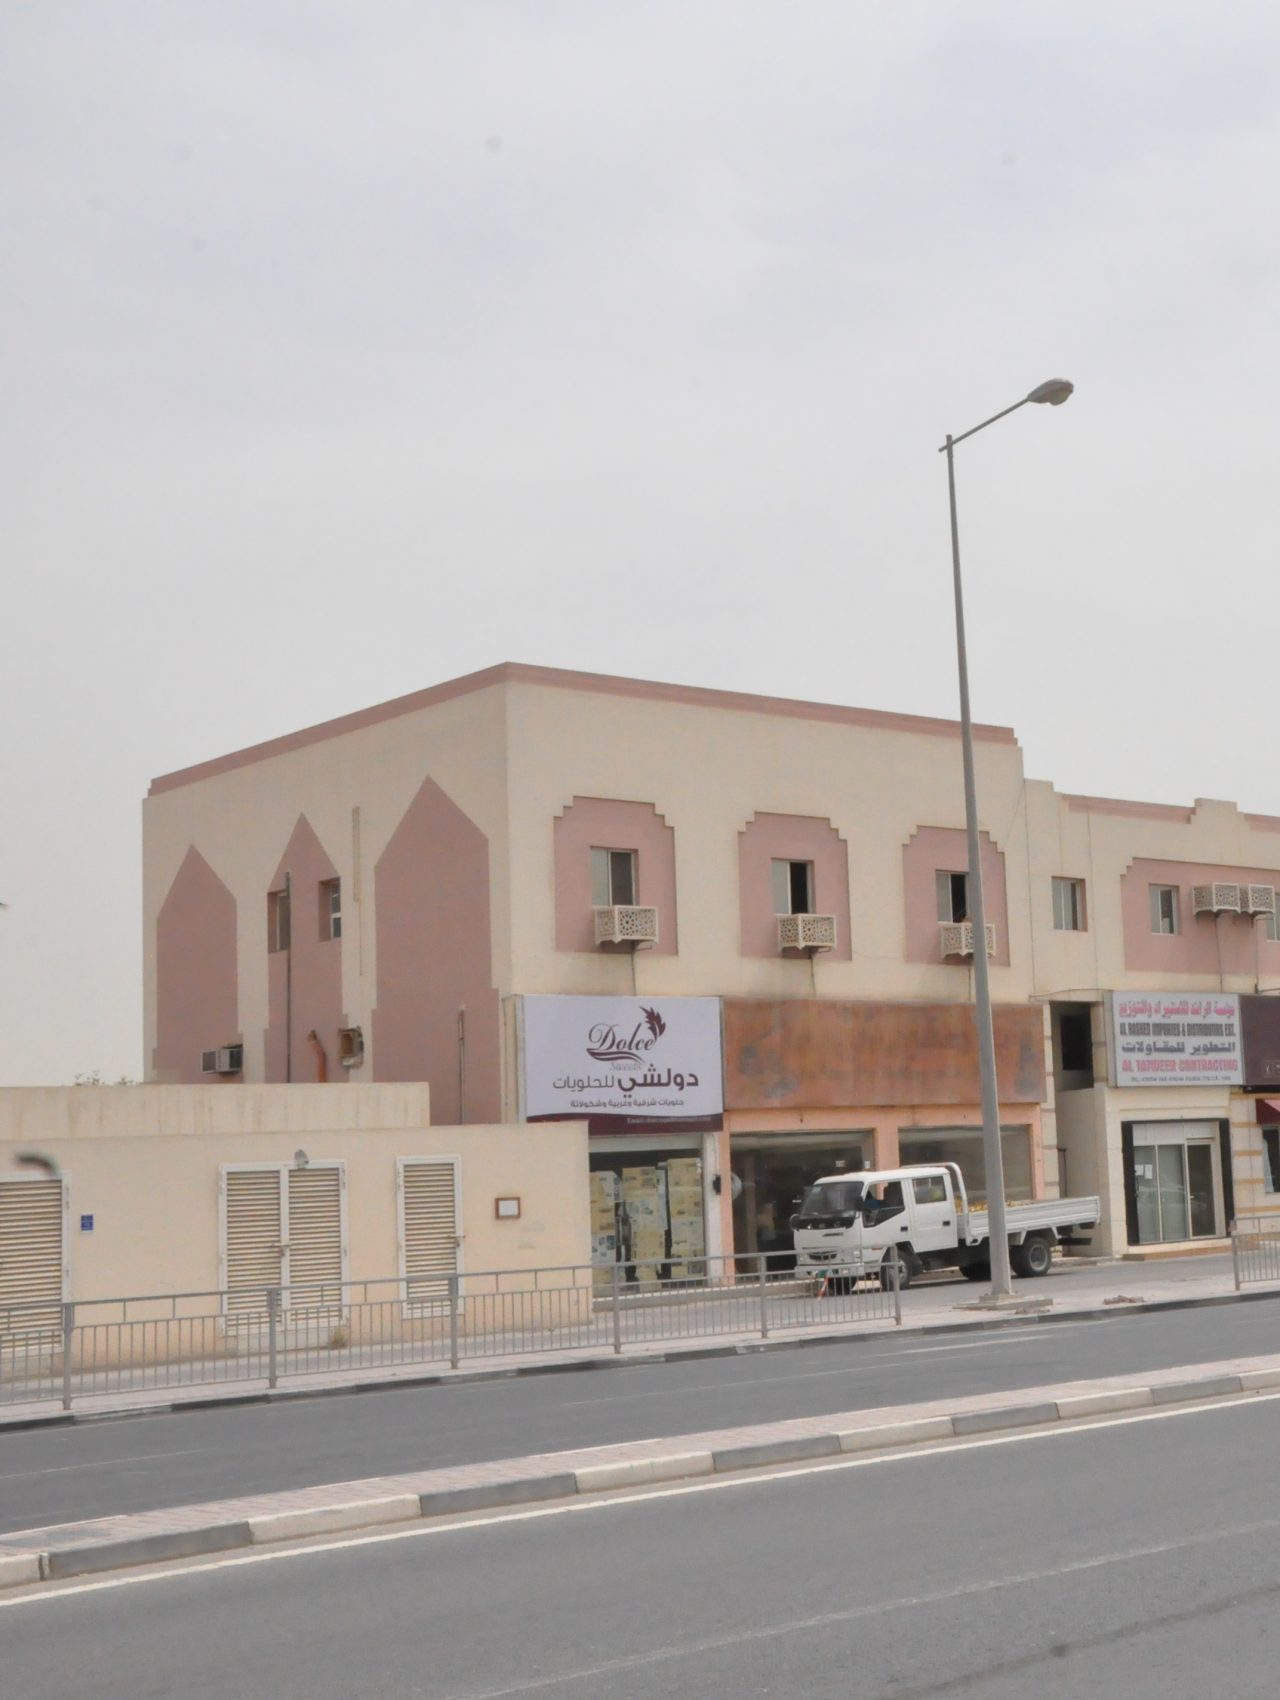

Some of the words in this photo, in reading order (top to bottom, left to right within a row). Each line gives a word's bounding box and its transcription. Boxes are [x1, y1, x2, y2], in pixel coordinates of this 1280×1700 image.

[588, 1022, 656, 1051] Dolce
[1121, 1041, 1185, 1055] للمقاولات
[1189, 1042, 1236, 1056] التطوير
[1122, 1059, 1134, 1072] AL
[1179, 1059, 1238, 1072] CONTRACTING
[553, 1074, 615, 1093] للحلويات
[617, 1064, 699, 1098] دولشي
[608, 1099, 632, 1108] وغربية
[633, 1097, 657, 1108] شرقية
[658, 1099, 685, 1107] حلويات
